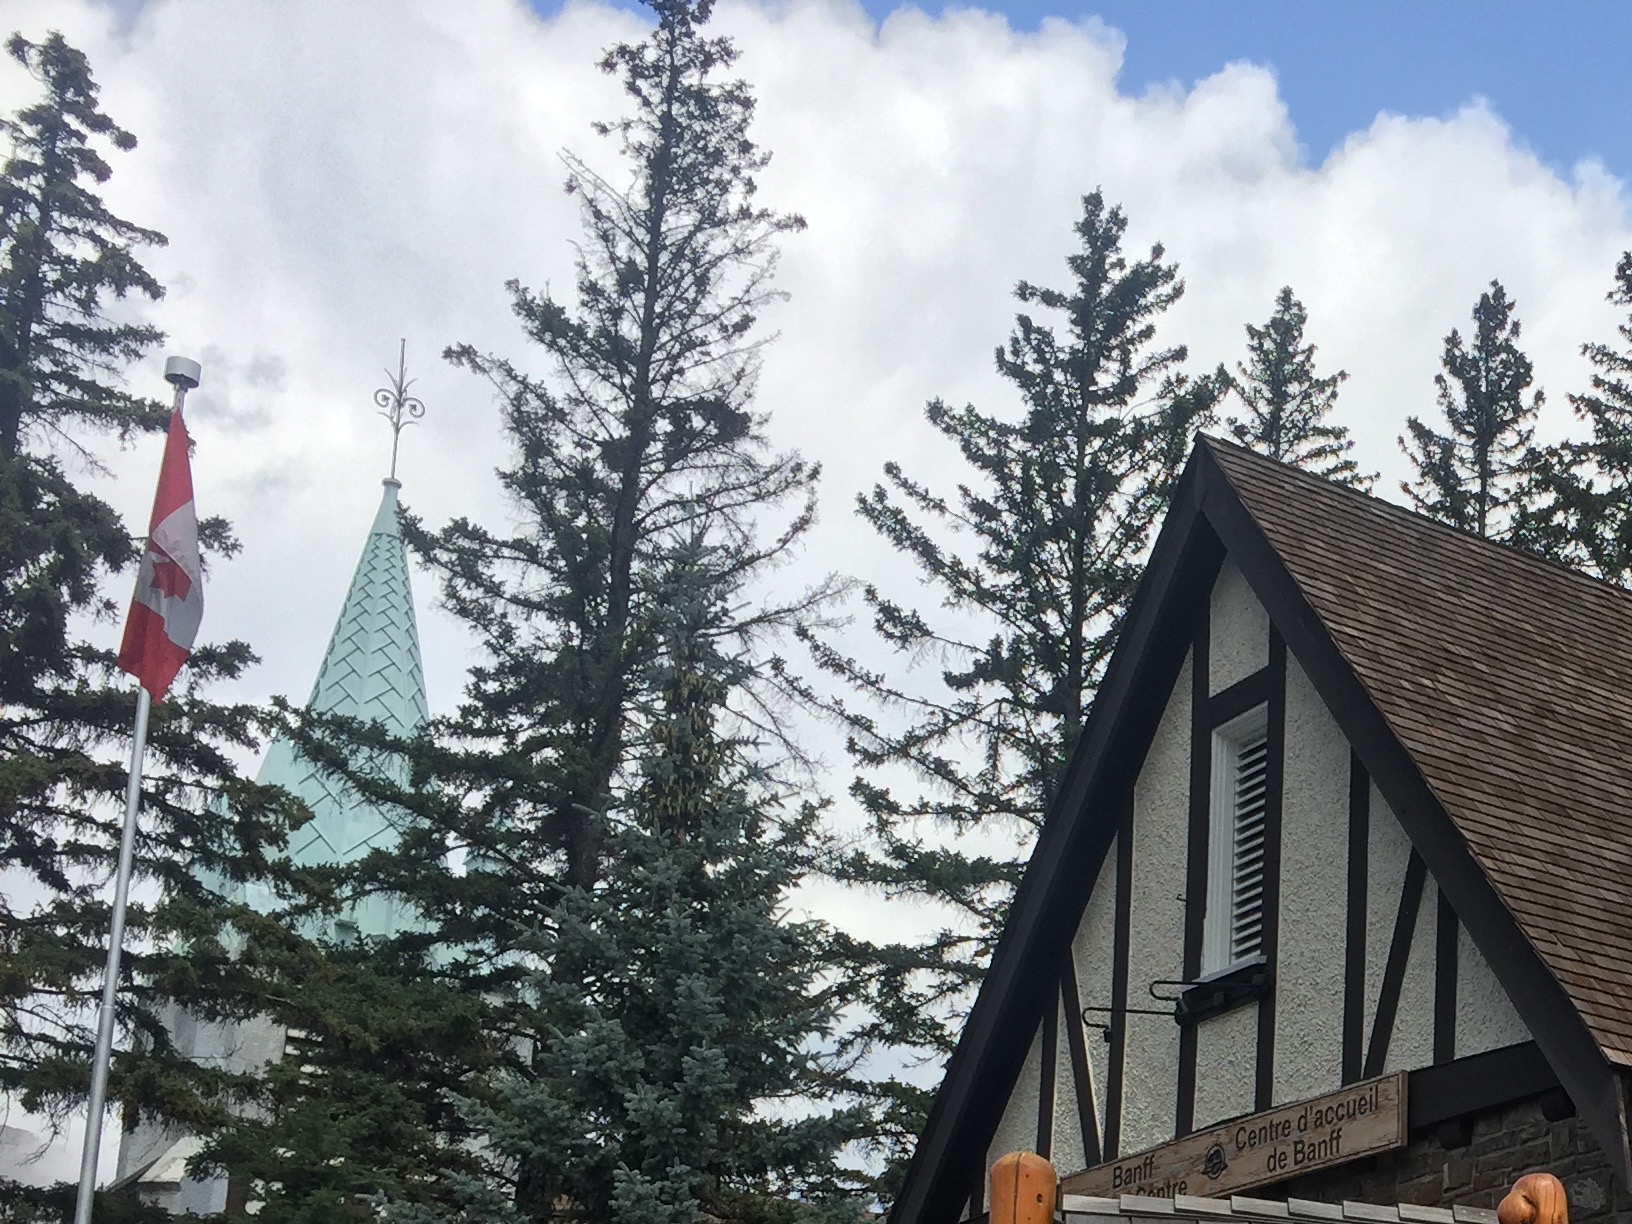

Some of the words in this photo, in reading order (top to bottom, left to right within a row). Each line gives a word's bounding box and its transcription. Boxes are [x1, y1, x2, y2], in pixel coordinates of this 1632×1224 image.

[1236, 1118, 1291, 1151] Centre
[1297, 1085, 1379, 1133] d'accueil
[1112, 1154, 1155, 1189] Banff
[1267, 1146, 1288, 1173] de
[1293, 1127, 1343, 1167] Banff
